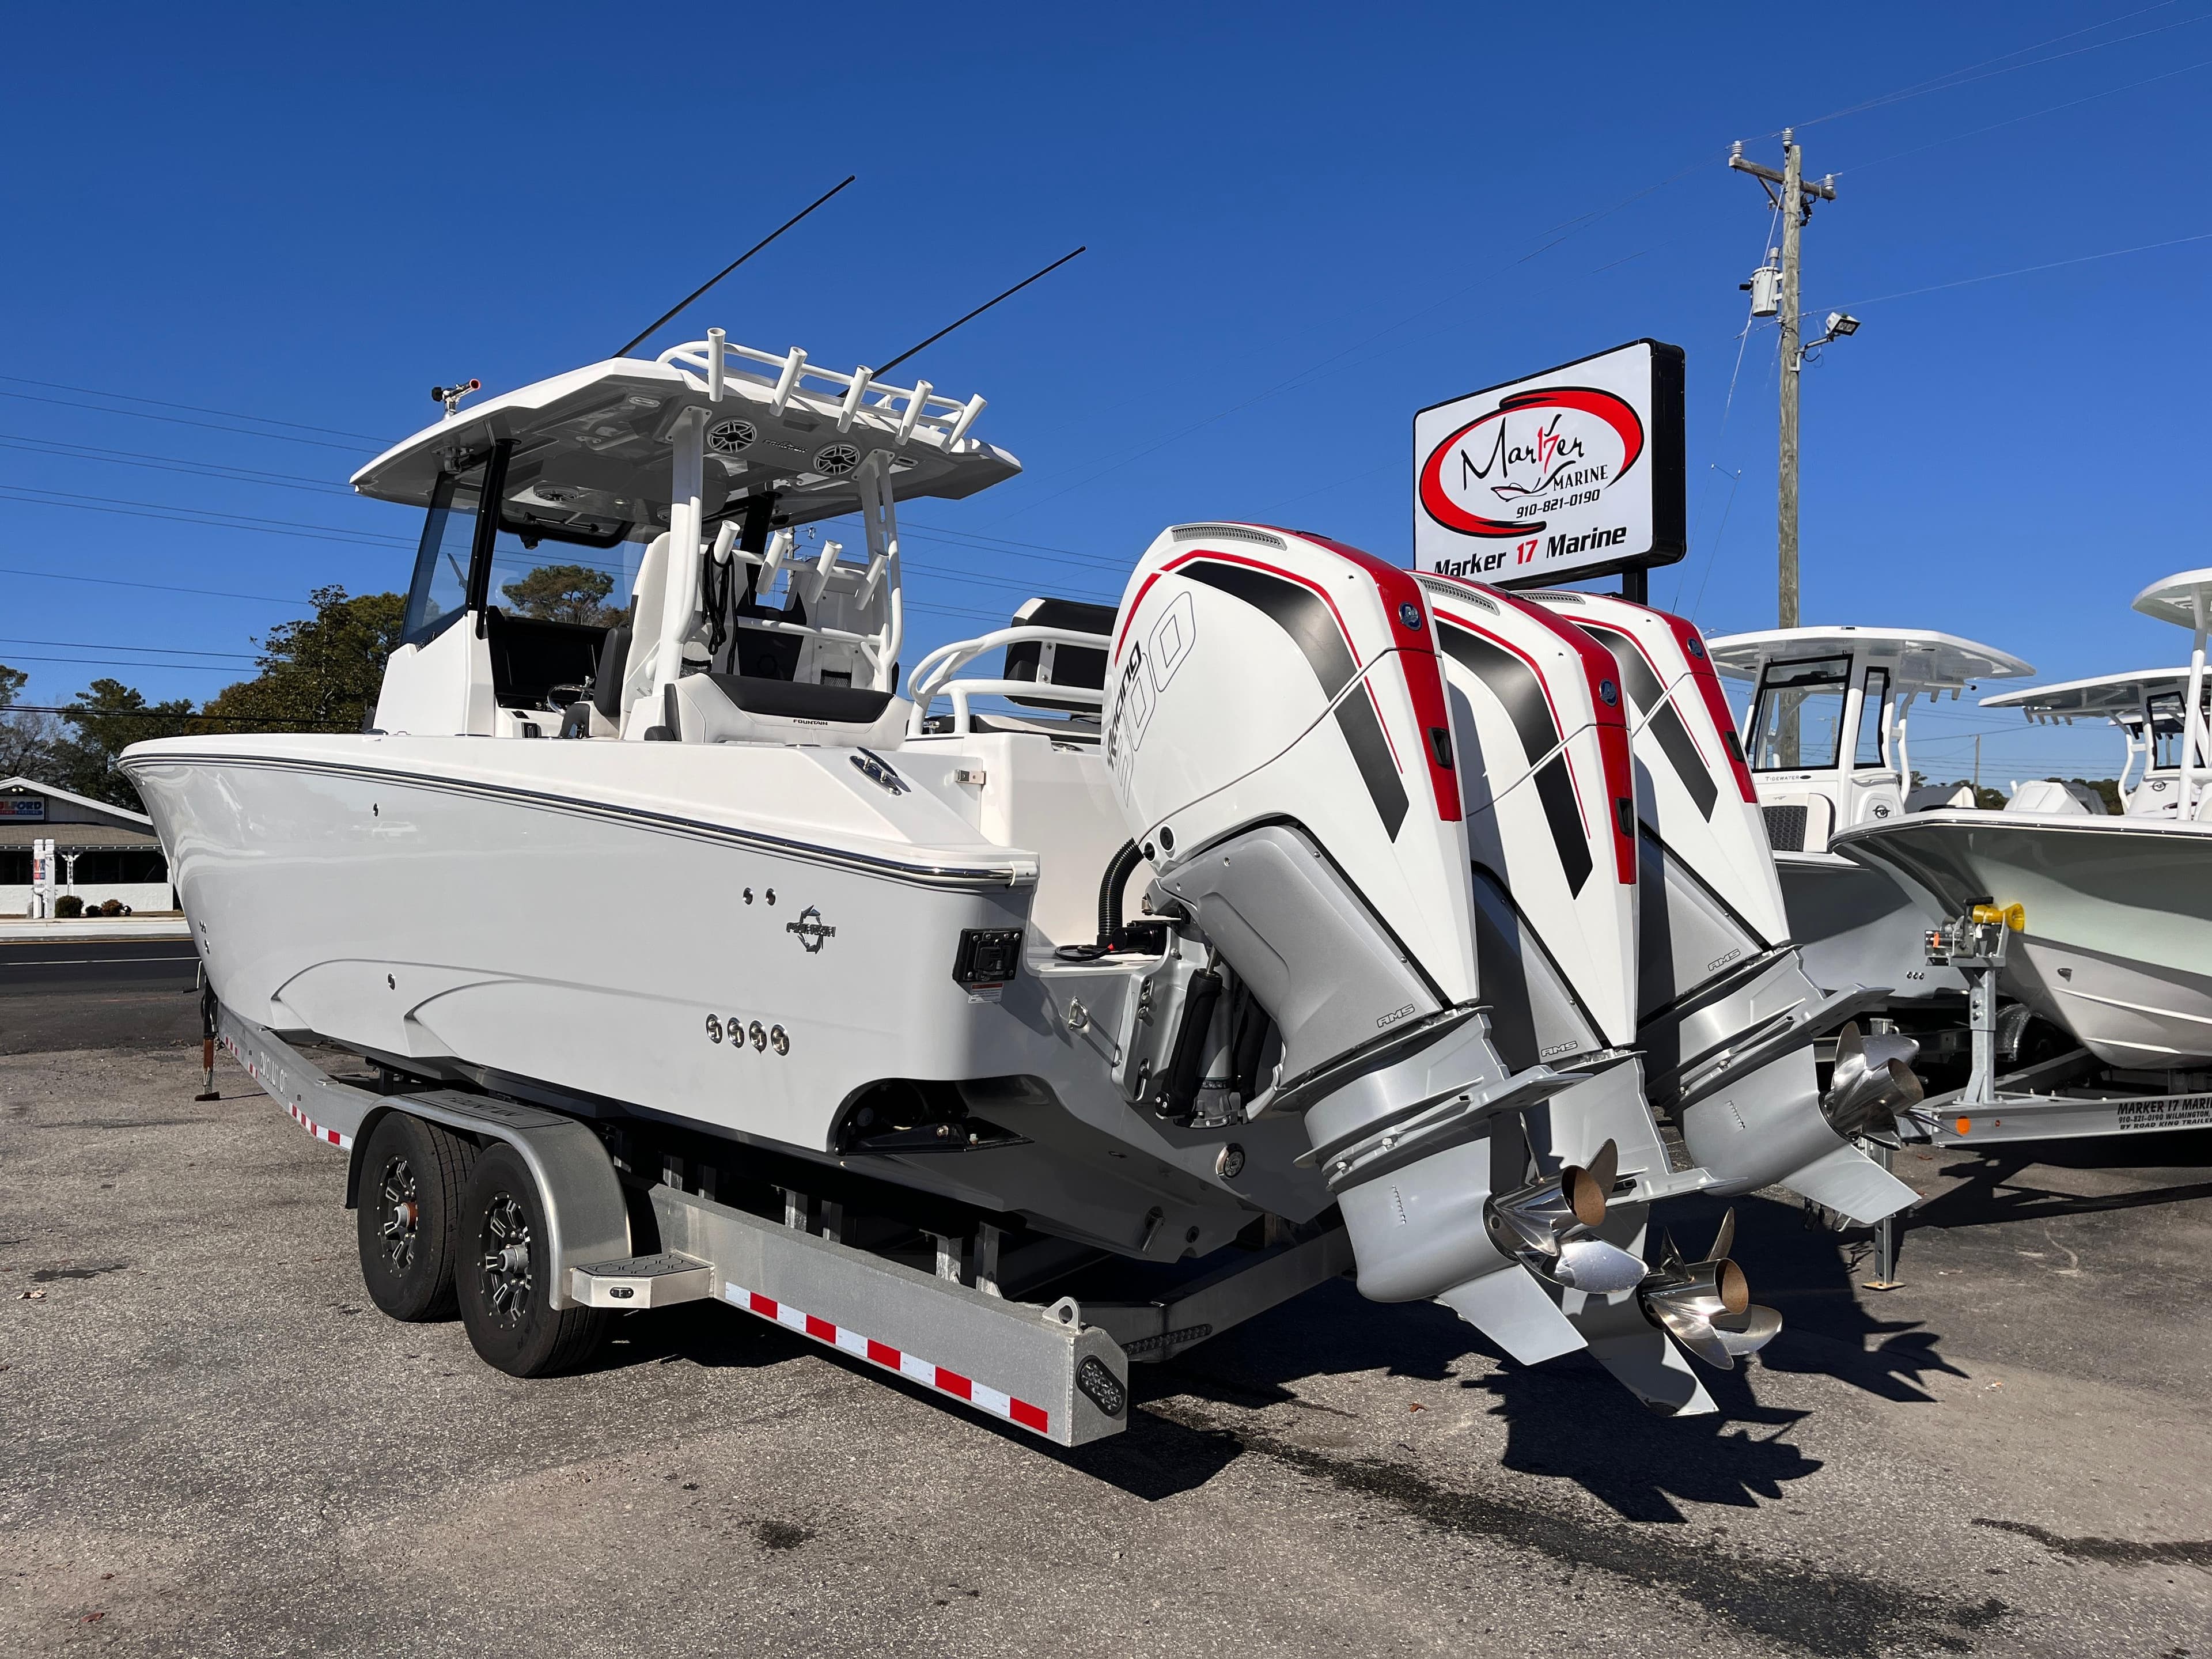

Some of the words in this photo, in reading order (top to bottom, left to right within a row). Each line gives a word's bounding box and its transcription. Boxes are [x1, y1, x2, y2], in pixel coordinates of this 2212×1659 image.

[1553, 464, 1608, 491] MARINE
[1516, 489, 1600, 518] 910-821-0190
[1434, 552, 1506, 578] Marker
[1517, 539, 1538, 565] 17
[1546, 527, 1627, 558] Marine
[1707, 948, 1741, 971] AMS
[1377, 1003, 1415, 1028] AMS
[1541, 1040, 1578, 1057] AMS
[2118, 1100, 2165, 1115] MARKER
[2168, 1100, 2179, 1112] 17
[2119, 1113, 2164, 1123] 910-821-0190
[2166, 1110, 2210, 1120] WILMINGTON,
